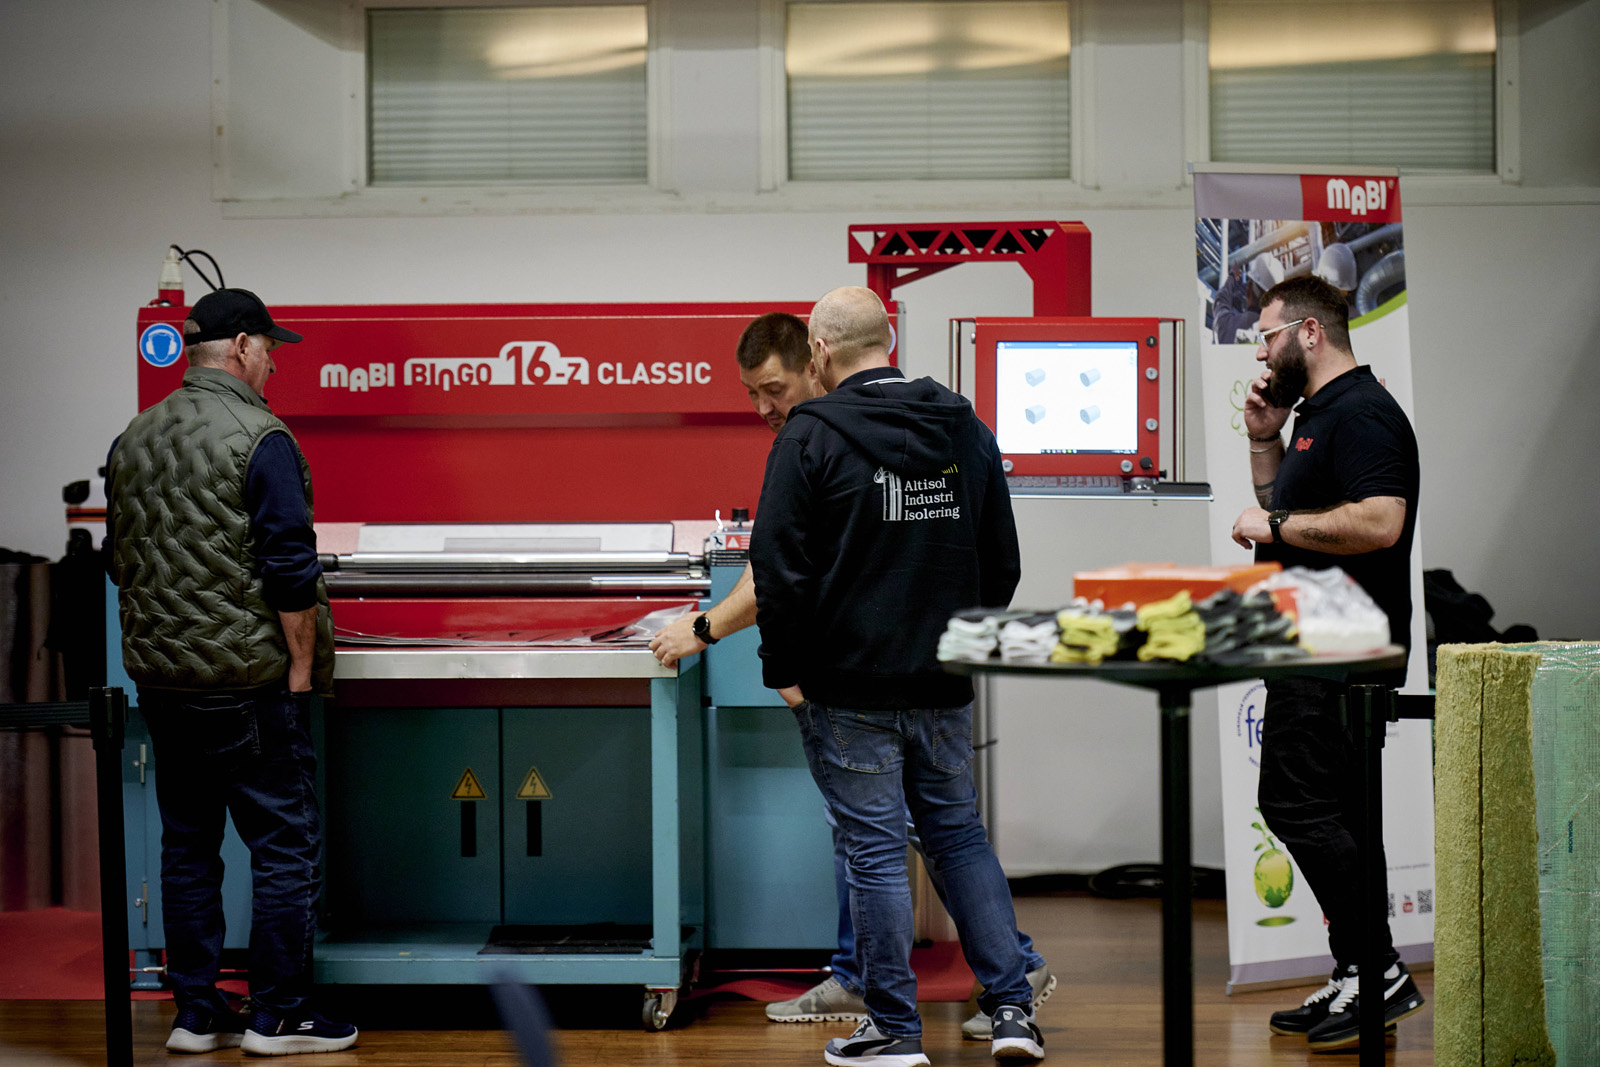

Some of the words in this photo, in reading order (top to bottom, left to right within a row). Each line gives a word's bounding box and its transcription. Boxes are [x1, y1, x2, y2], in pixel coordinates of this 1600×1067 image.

[320, 362, 395, 392] MABI
[411, 363, 493, 387] BINGO
[598, 362, 712, 385] CLASSIC
[905, 477, 946, 491] Altisol
[905, 491, 954, 505] Industri
[904, 506, 960, 520] Isolering
